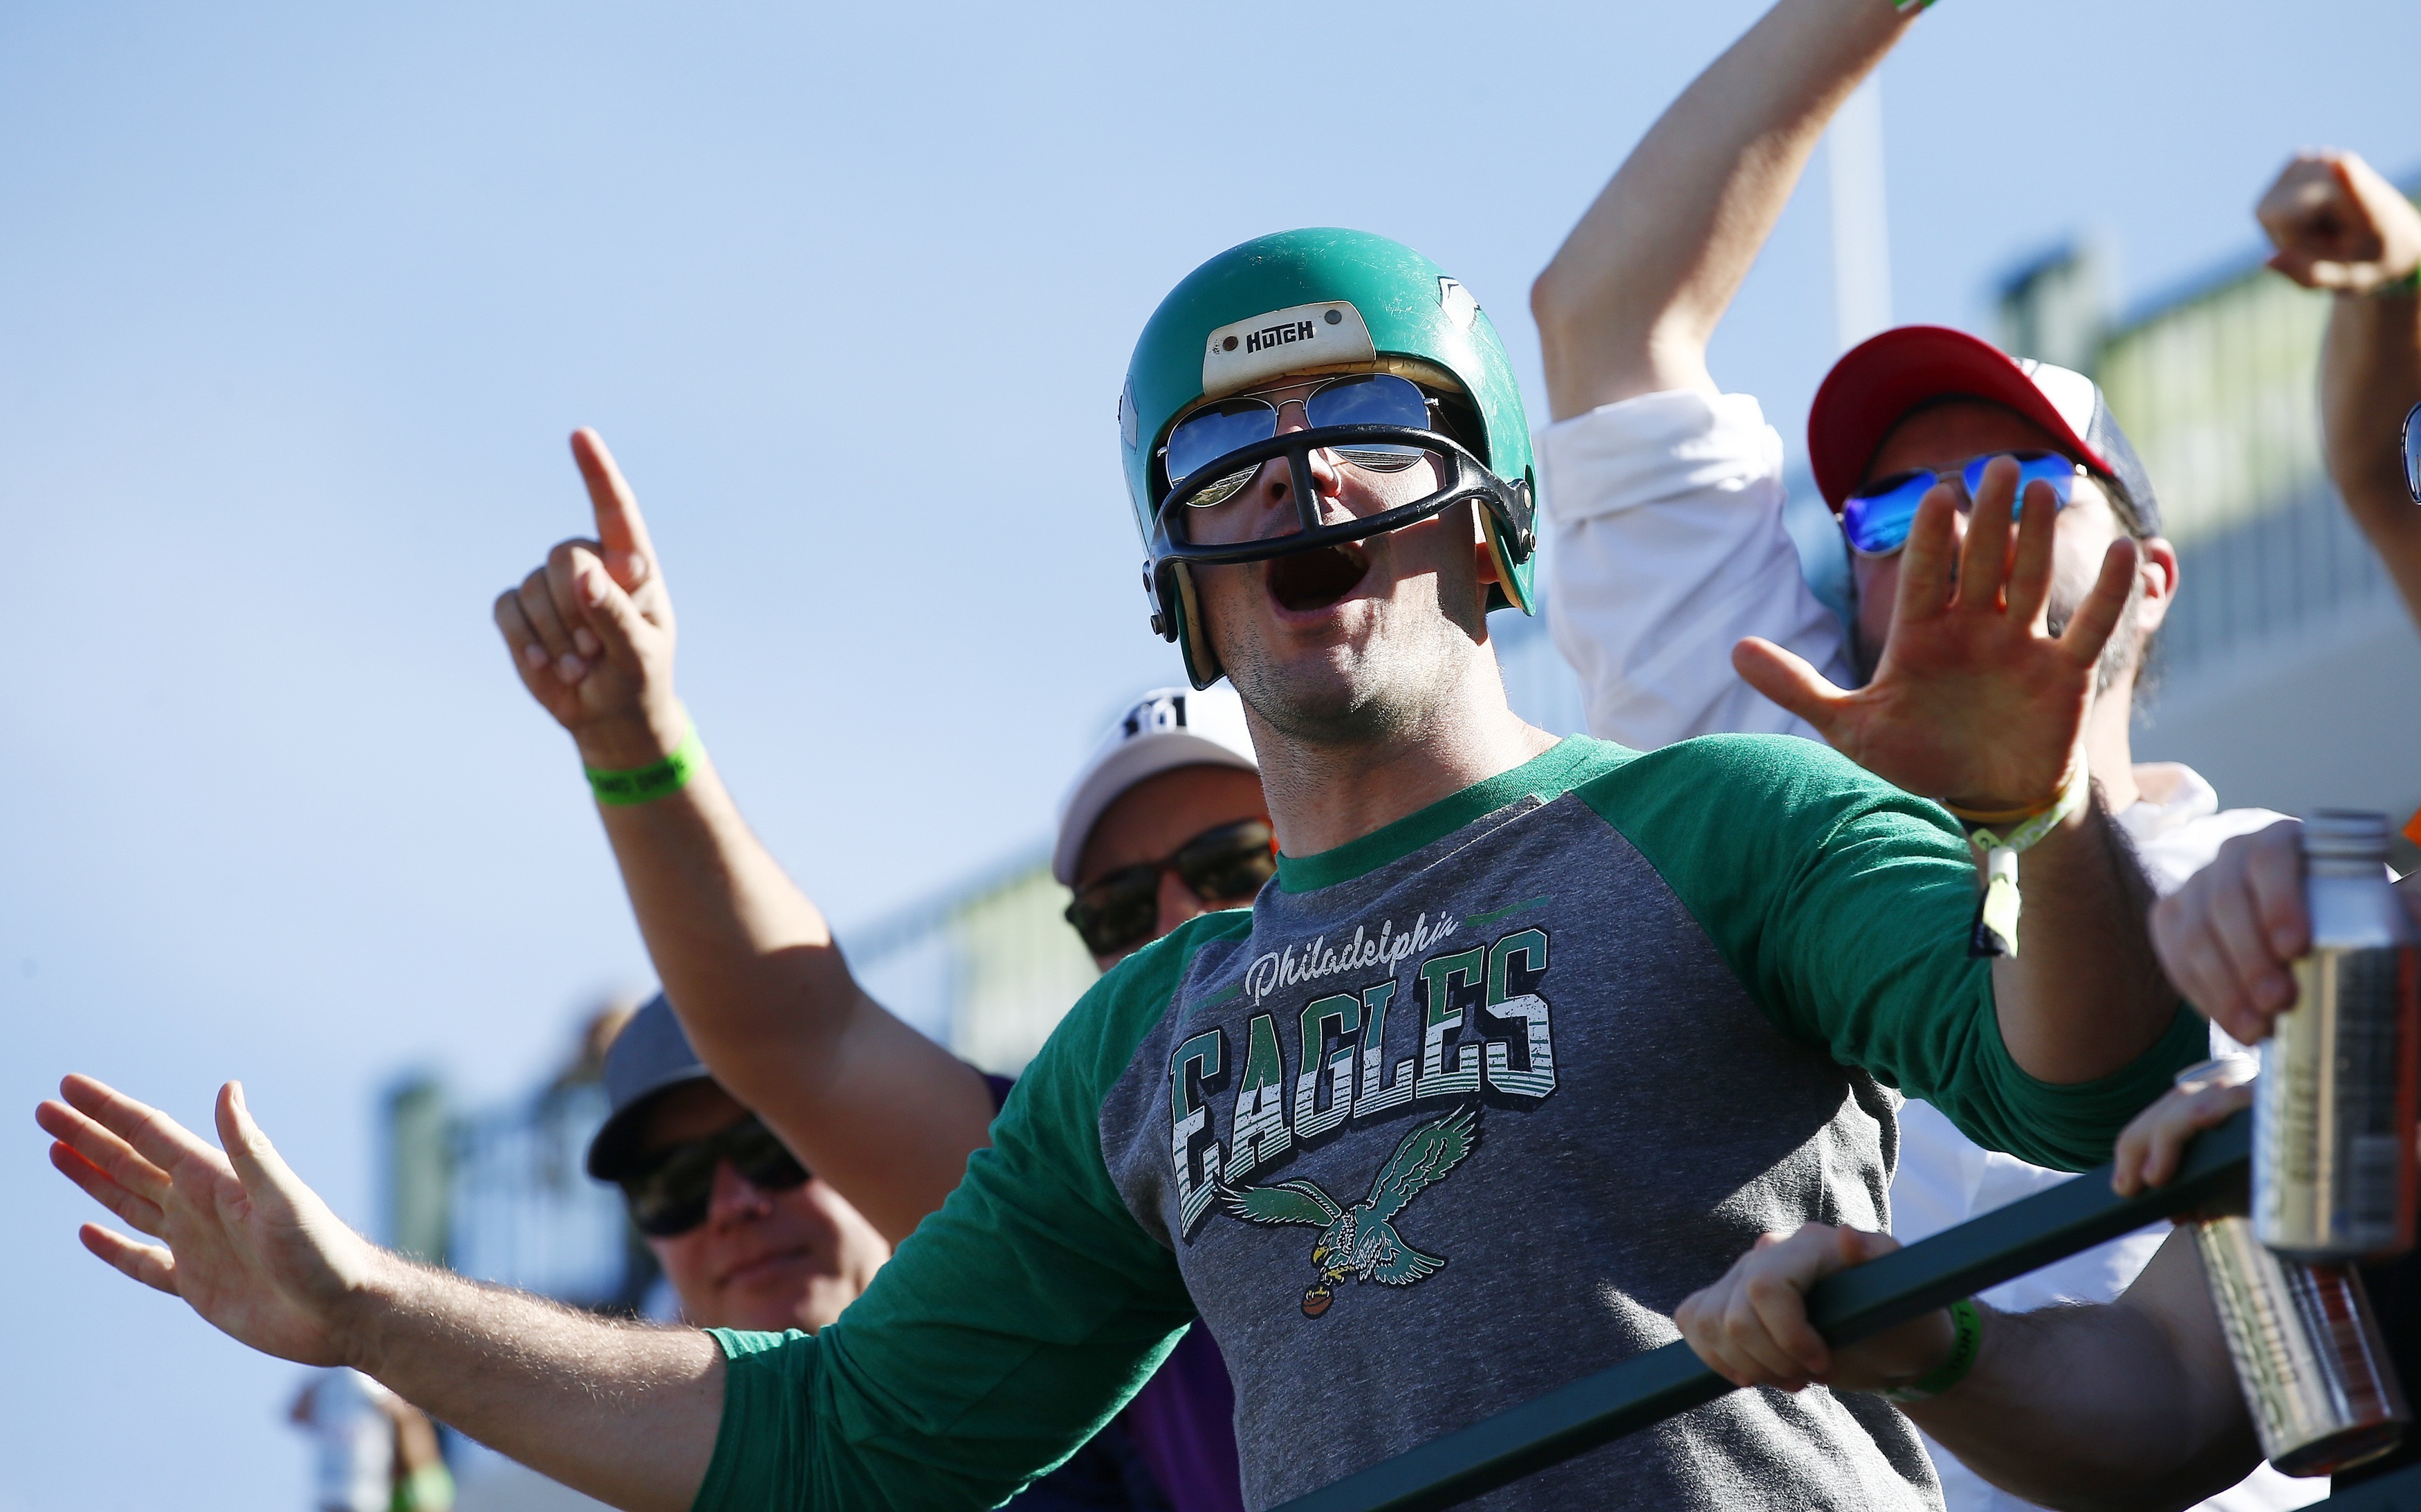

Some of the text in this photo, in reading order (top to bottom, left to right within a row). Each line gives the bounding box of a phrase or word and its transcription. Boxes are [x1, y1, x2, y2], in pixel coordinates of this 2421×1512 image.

[1246, 320, 1314, 353] HUTCH
[1245, 911, 1459, 1006] Philadelphia
[1170, 927, 1558, 1242] EAGLES
